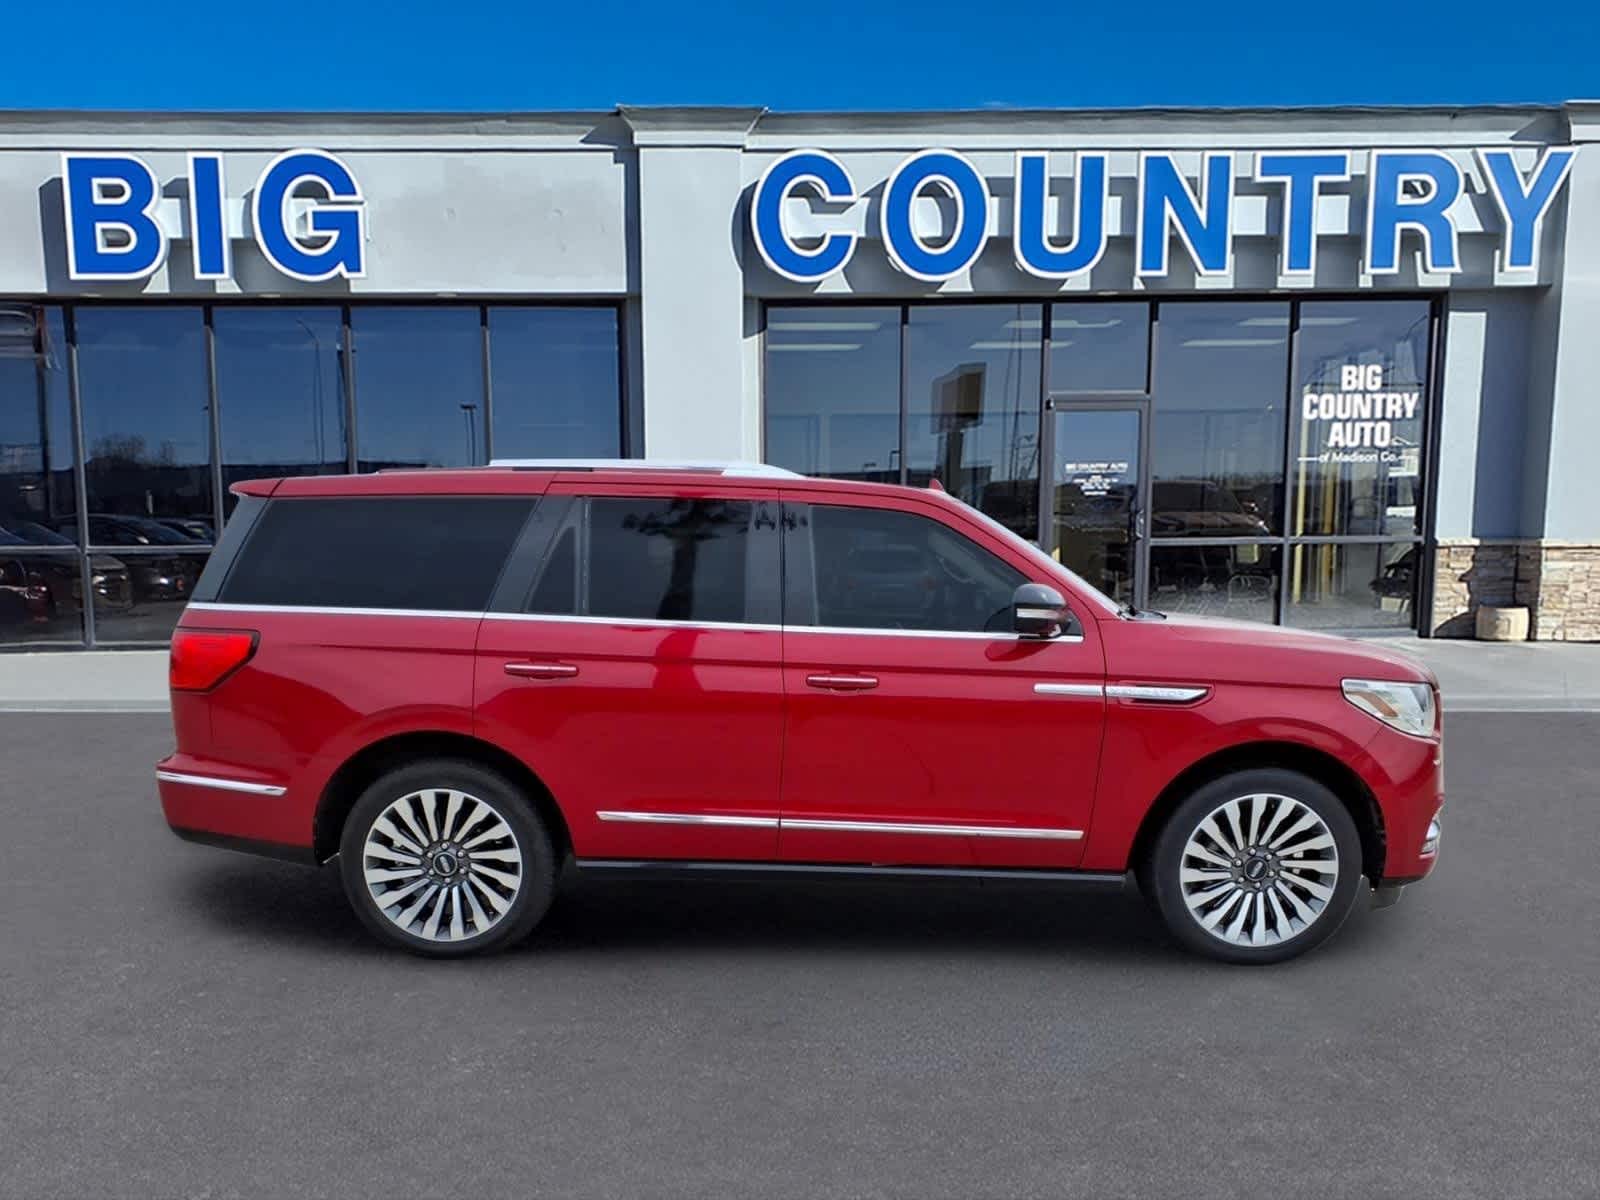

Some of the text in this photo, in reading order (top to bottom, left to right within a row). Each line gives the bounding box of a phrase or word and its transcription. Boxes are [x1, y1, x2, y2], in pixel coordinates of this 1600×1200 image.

[61, 148, 1574, 282] BIG COUNTRY
[1341, 364, 1382, 391] BIG
[1303, 392, 1419, 419] COUNTRY
[1327, 421, 1391, 447] AUTO
[1319, 452, 1330, 463] of
[1331, 451, 1378, 462] Madison
